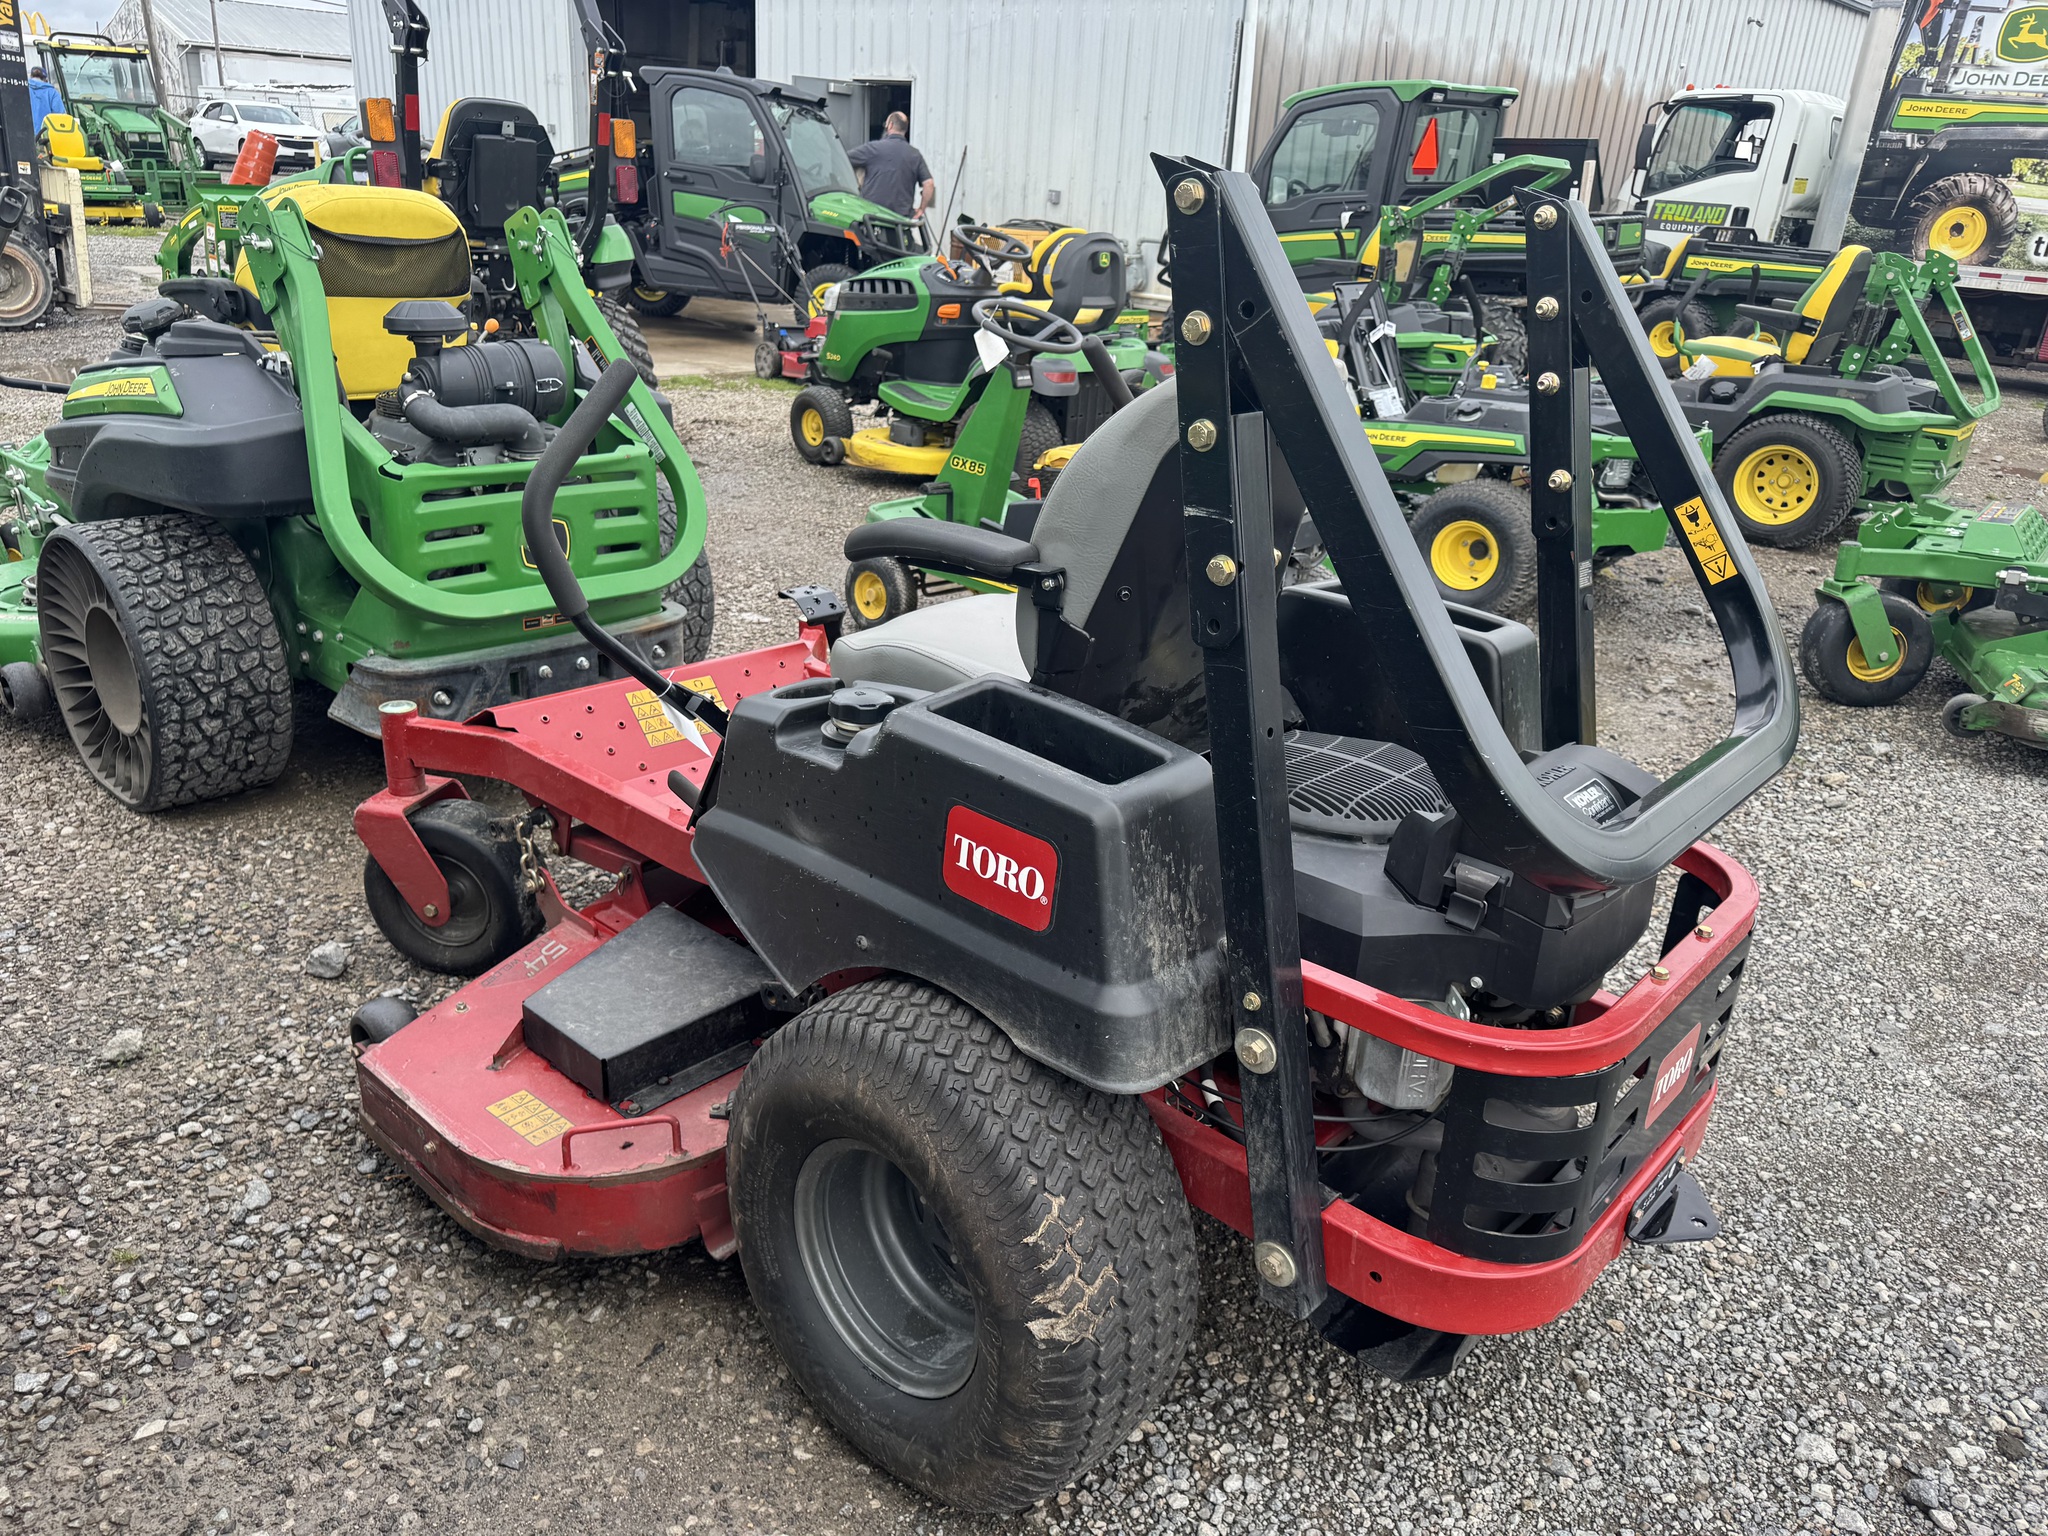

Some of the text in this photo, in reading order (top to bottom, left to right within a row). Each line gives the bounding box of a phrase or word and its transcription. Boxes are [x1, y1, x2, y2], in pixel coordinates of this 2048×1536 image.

[1954, 71, 2010, 86] JOHN
[1906, 104, 1968, 115] JOHN DEERE
[1653, 203, 1727, 225] TRULAND
[1691, 259, 1734, 269] JOHN DEERE
[105, 380, 149, 395] JOHN DEERE
[1379, 433, 1407, 442] DEERE
[951, 456, 986, 475] GX85
[1572, 786, 1602, 808] KOHLER
[953, 833, 1045, 901] TORO
[1653, 1047, 1693, 1106] TORO
